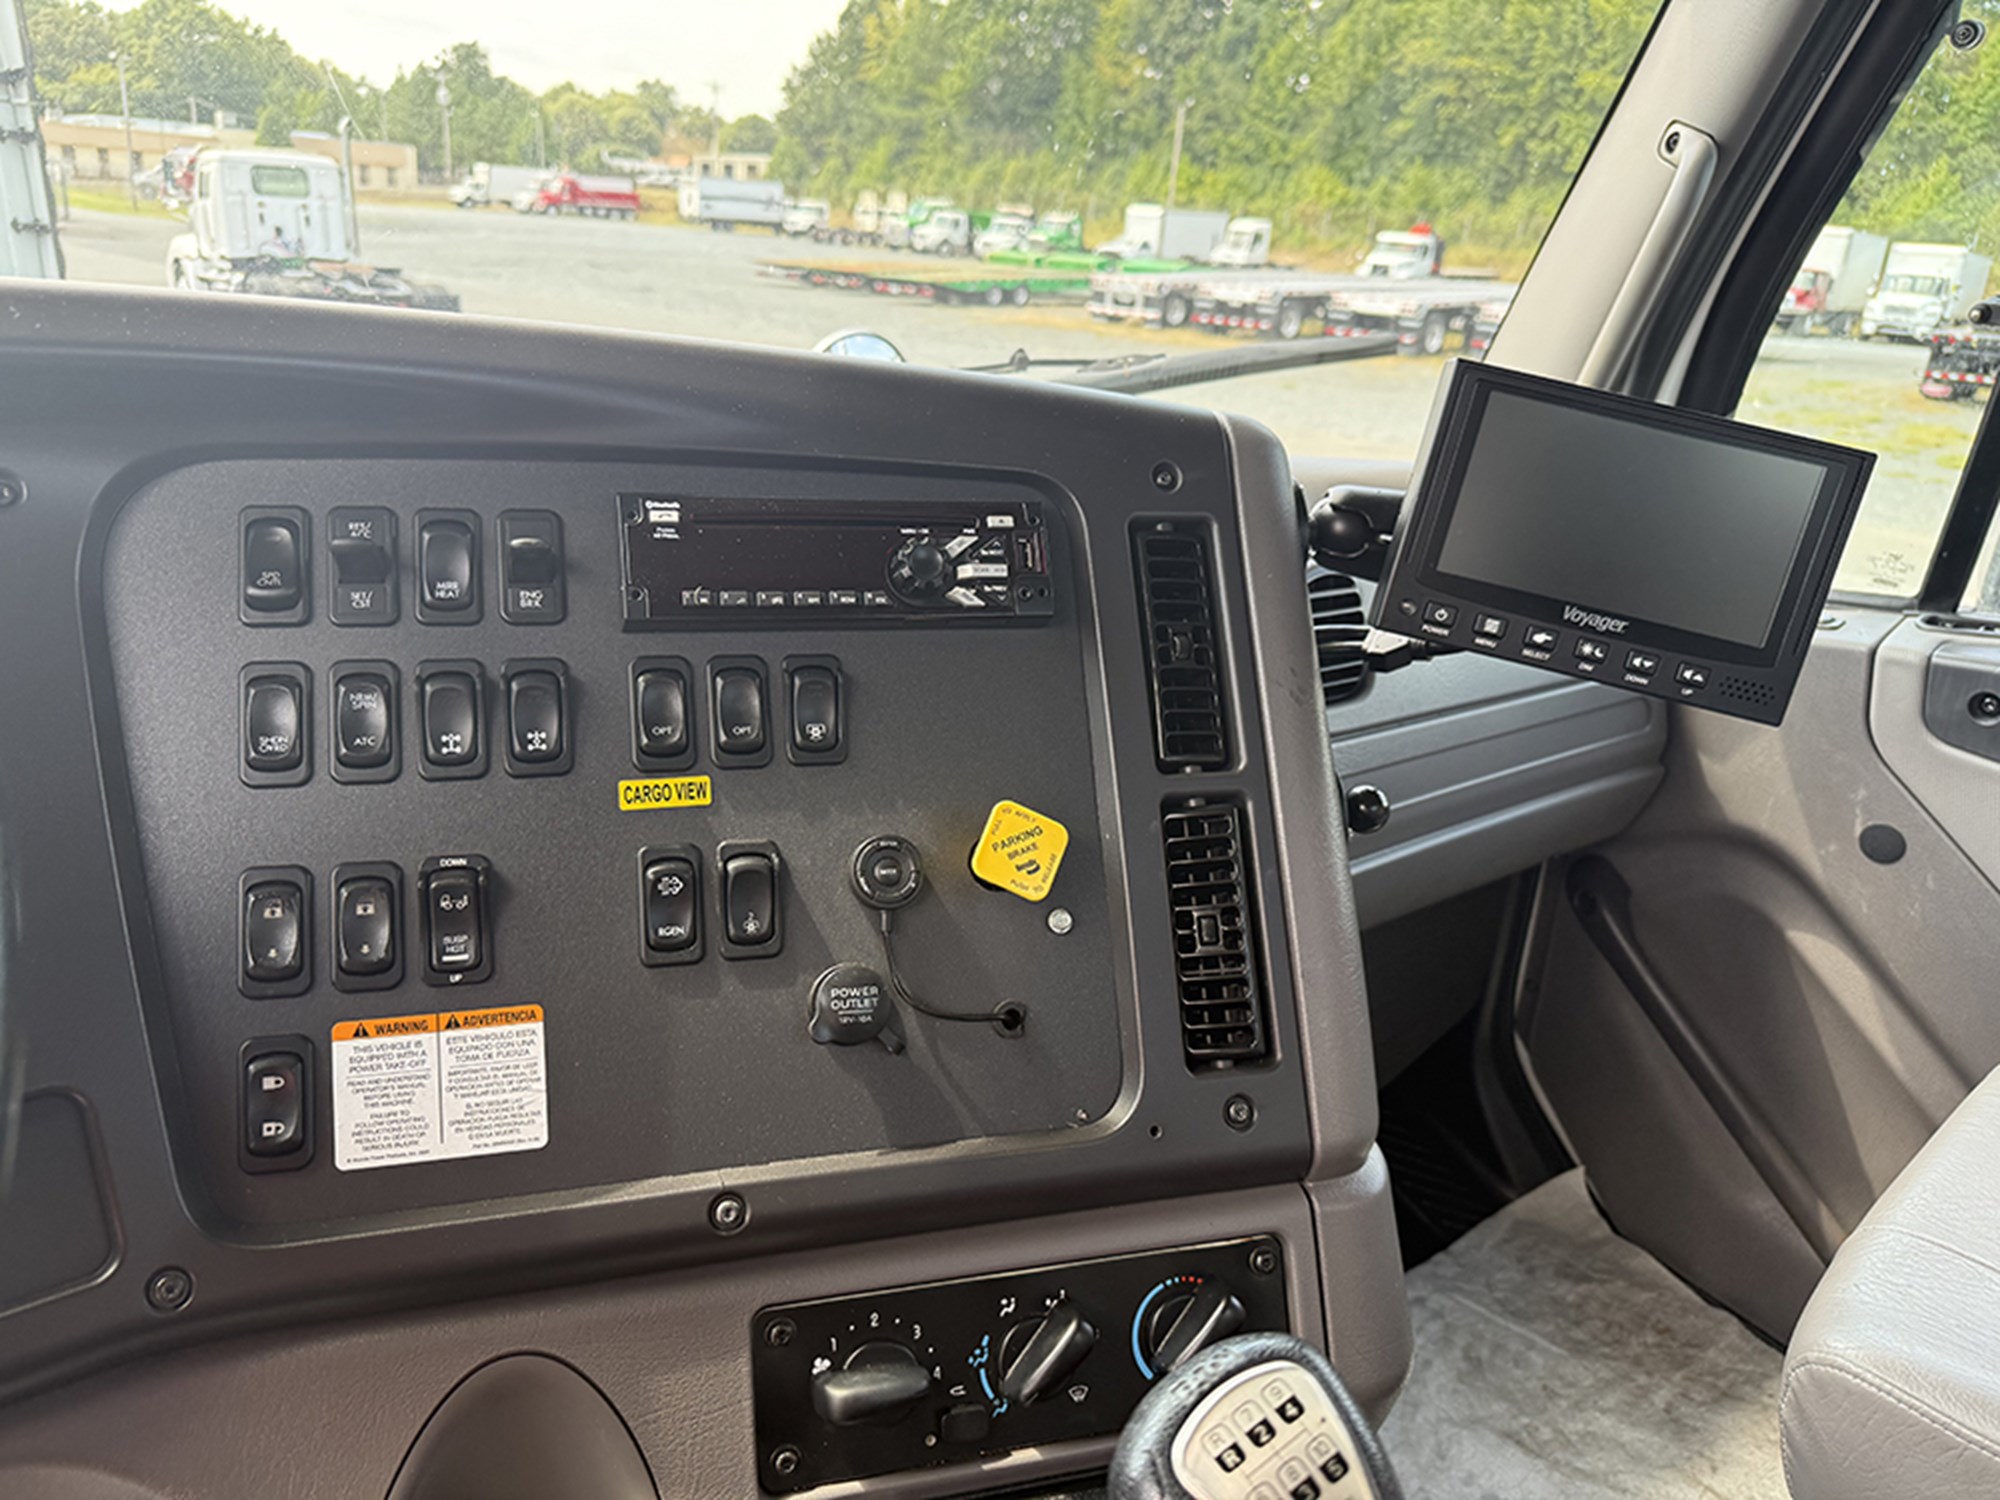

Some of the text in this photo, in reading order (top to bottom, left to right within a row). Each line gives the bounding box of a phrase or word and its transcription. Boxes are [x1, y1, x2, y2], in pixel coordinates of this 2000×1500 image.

[519, 589, 544, 600] ENG
[1562, 604, 1630, 634] Voyager
[1421, 623, 1450, 638] POWER
[1474, 636, 1498, 649] MENU
[1521, 648, 1551, 661] SELECT
[651, 725, 673, 736] OPT
[732, 725, 752, 736] OPT
[353, 735, 376, 746] ATC
[623, 781, 708, 805] CARGO VIEW
[991, 825, 1044, 853] PARKING
[1007, 842, 1039, 861] BRAKE
[439, 858, 468, 868] DOWN
[449, 973, 463, 983] UP
[830, 985, 879, 999] POWER
[830, 996, 879, 1011] OUTLET
[464, 1010, 536, 1026] ADVERTENCIA
[374, 1020, 428, 1035] WARNING
[830, 1311, 942, 1380] 1 2 3 4
[1269, 1384, 1283, 1400] 9
[1222, 1402, 1300, 1468] R 2 4
[1326, 1459, 1344, 1477] 5
